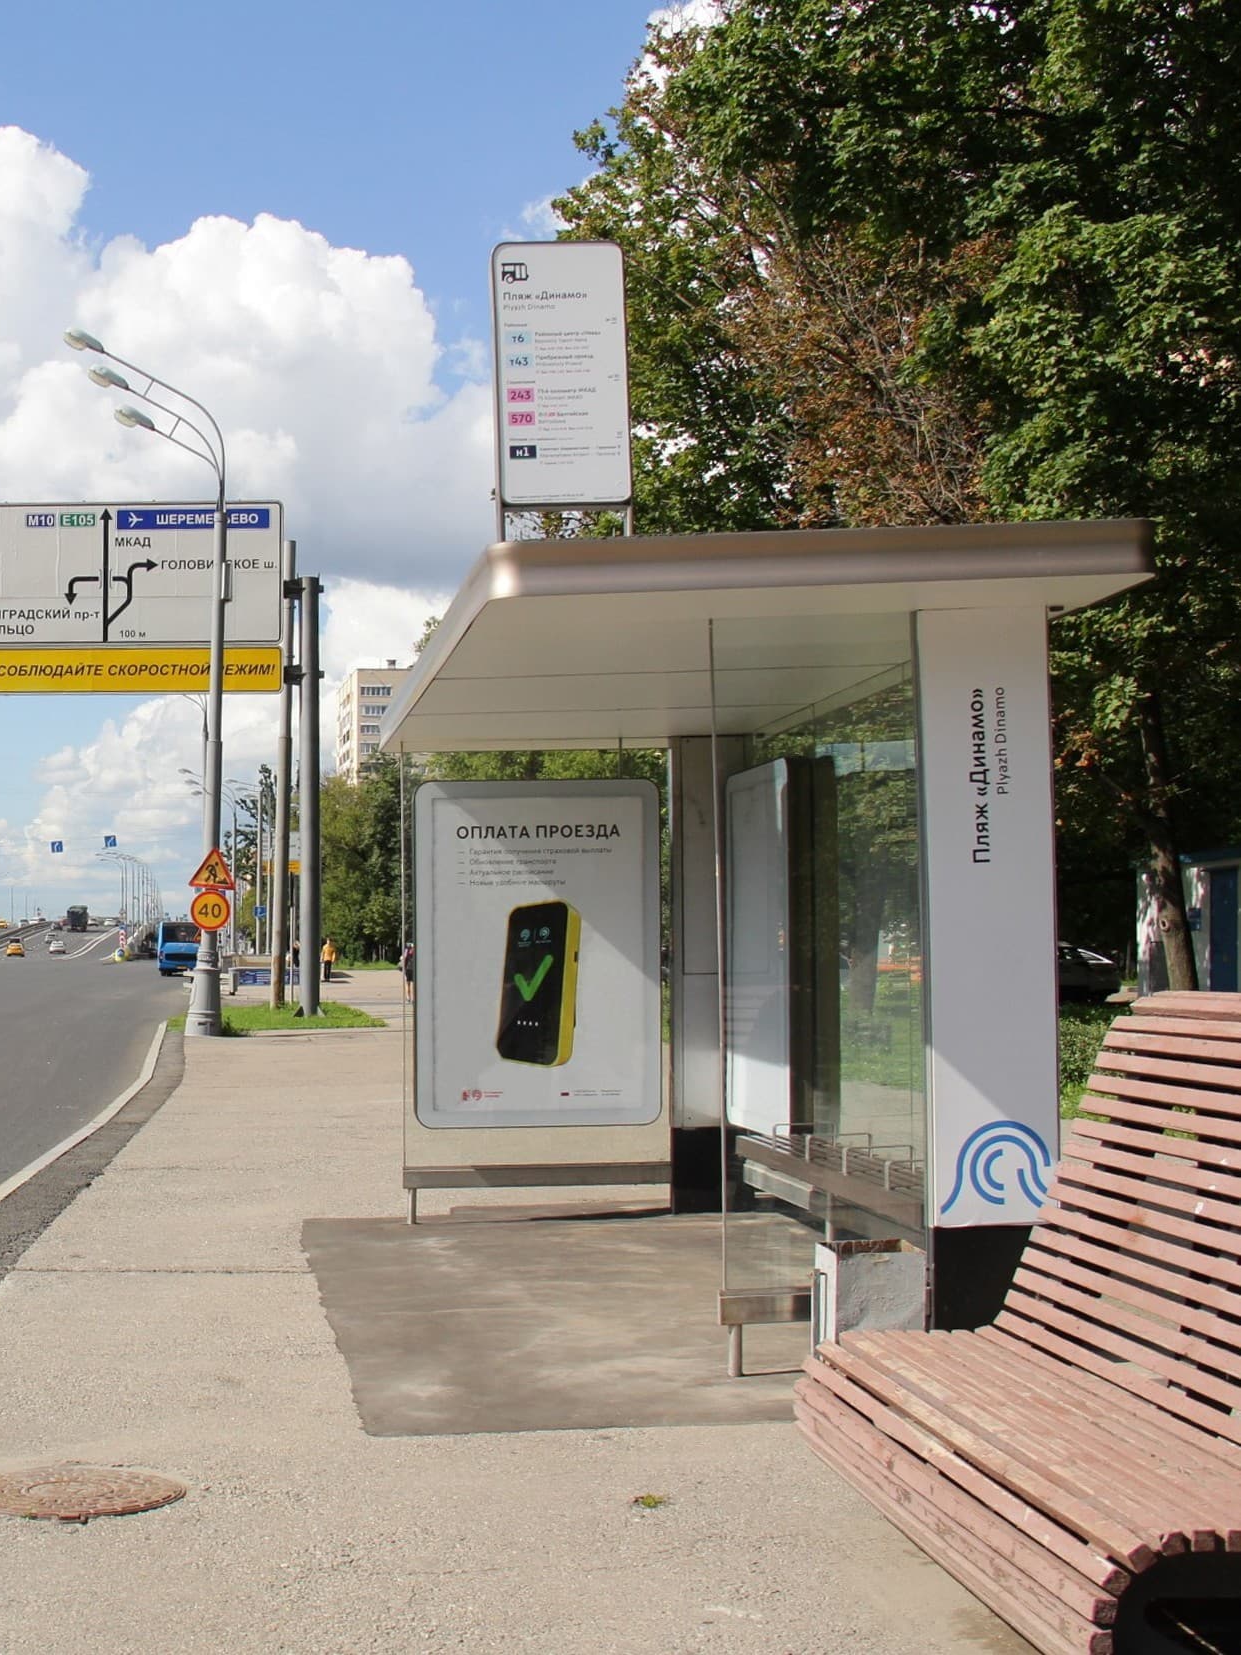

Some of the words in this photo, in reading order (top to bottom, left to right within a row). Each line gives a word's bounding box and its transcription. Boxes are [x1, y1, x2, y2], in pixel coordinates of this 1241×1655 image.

[502, 291, 532, 301] Пляж
[534, 290, 588, 301] «Динамо»
[511, 333, 525, 343] т6
[509, 356, 529, 367] т43
[510, 390, 531, 401] 243
[511, 413, 532, 424] 570
[156, 513, 259, 525] ШЕРЕМЕЕВО
[114, 537, 152, 548] МКАД
[161, 559, 260, 570] ГОЛОВИКОЕ
[263, 561, 278, 569] ш.
[74, 611, 100, 621] пр-т
[119, 630, 136, 638] 100
[108, 661, 211, 676] СКОРОСТНОЙ
[222, 663, 276, 676] ЕЖИМ!
[994, 687, 1008, 744] Dinamo
[969, 688, 991, 796] «Динамо»
[994, 747, 1011, 795] Plyazh
[456, 826, 531, 840] ОПЛАТА
[535, 824, 621, 840] ПРОЕЗДА
[972, 803, 991, 863] Пляж
[198, 903, 222, 919] 40
